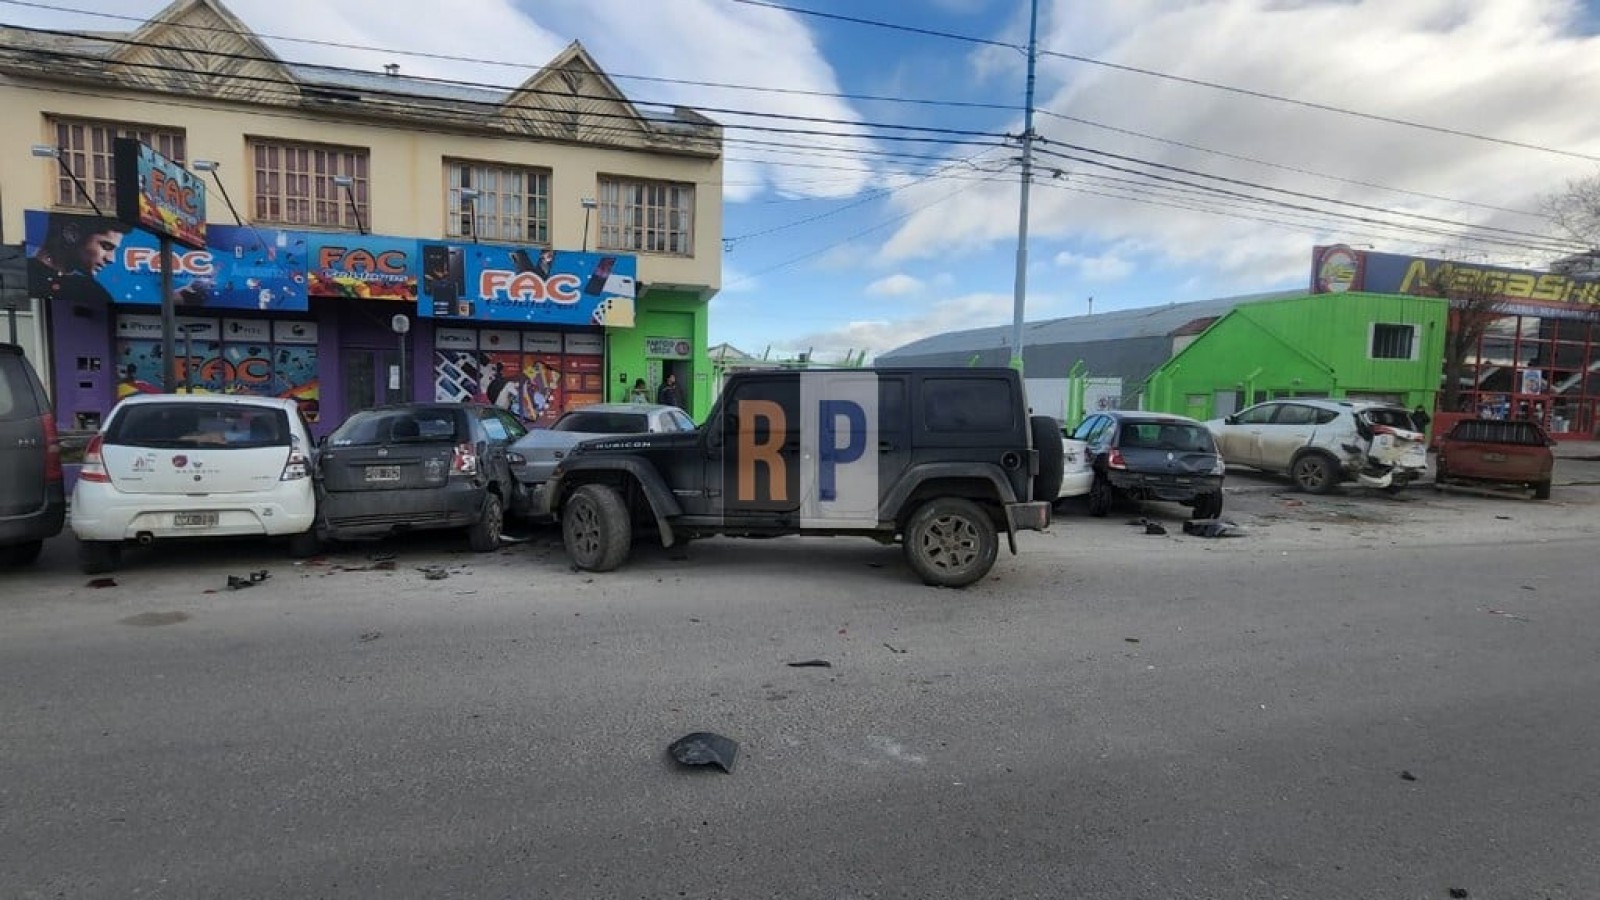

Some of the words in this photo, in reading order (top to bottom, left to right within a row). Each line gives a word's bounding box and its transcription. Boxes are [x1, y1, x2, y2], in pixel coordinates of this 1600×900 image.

[151, 167, 198, 214] FAC
[125, 247, 214, 275] FAC
[319, 246, 407, 274] FAC
[480, 270, 581, 305] FAC
[172, 355, 272, 384] FAC
